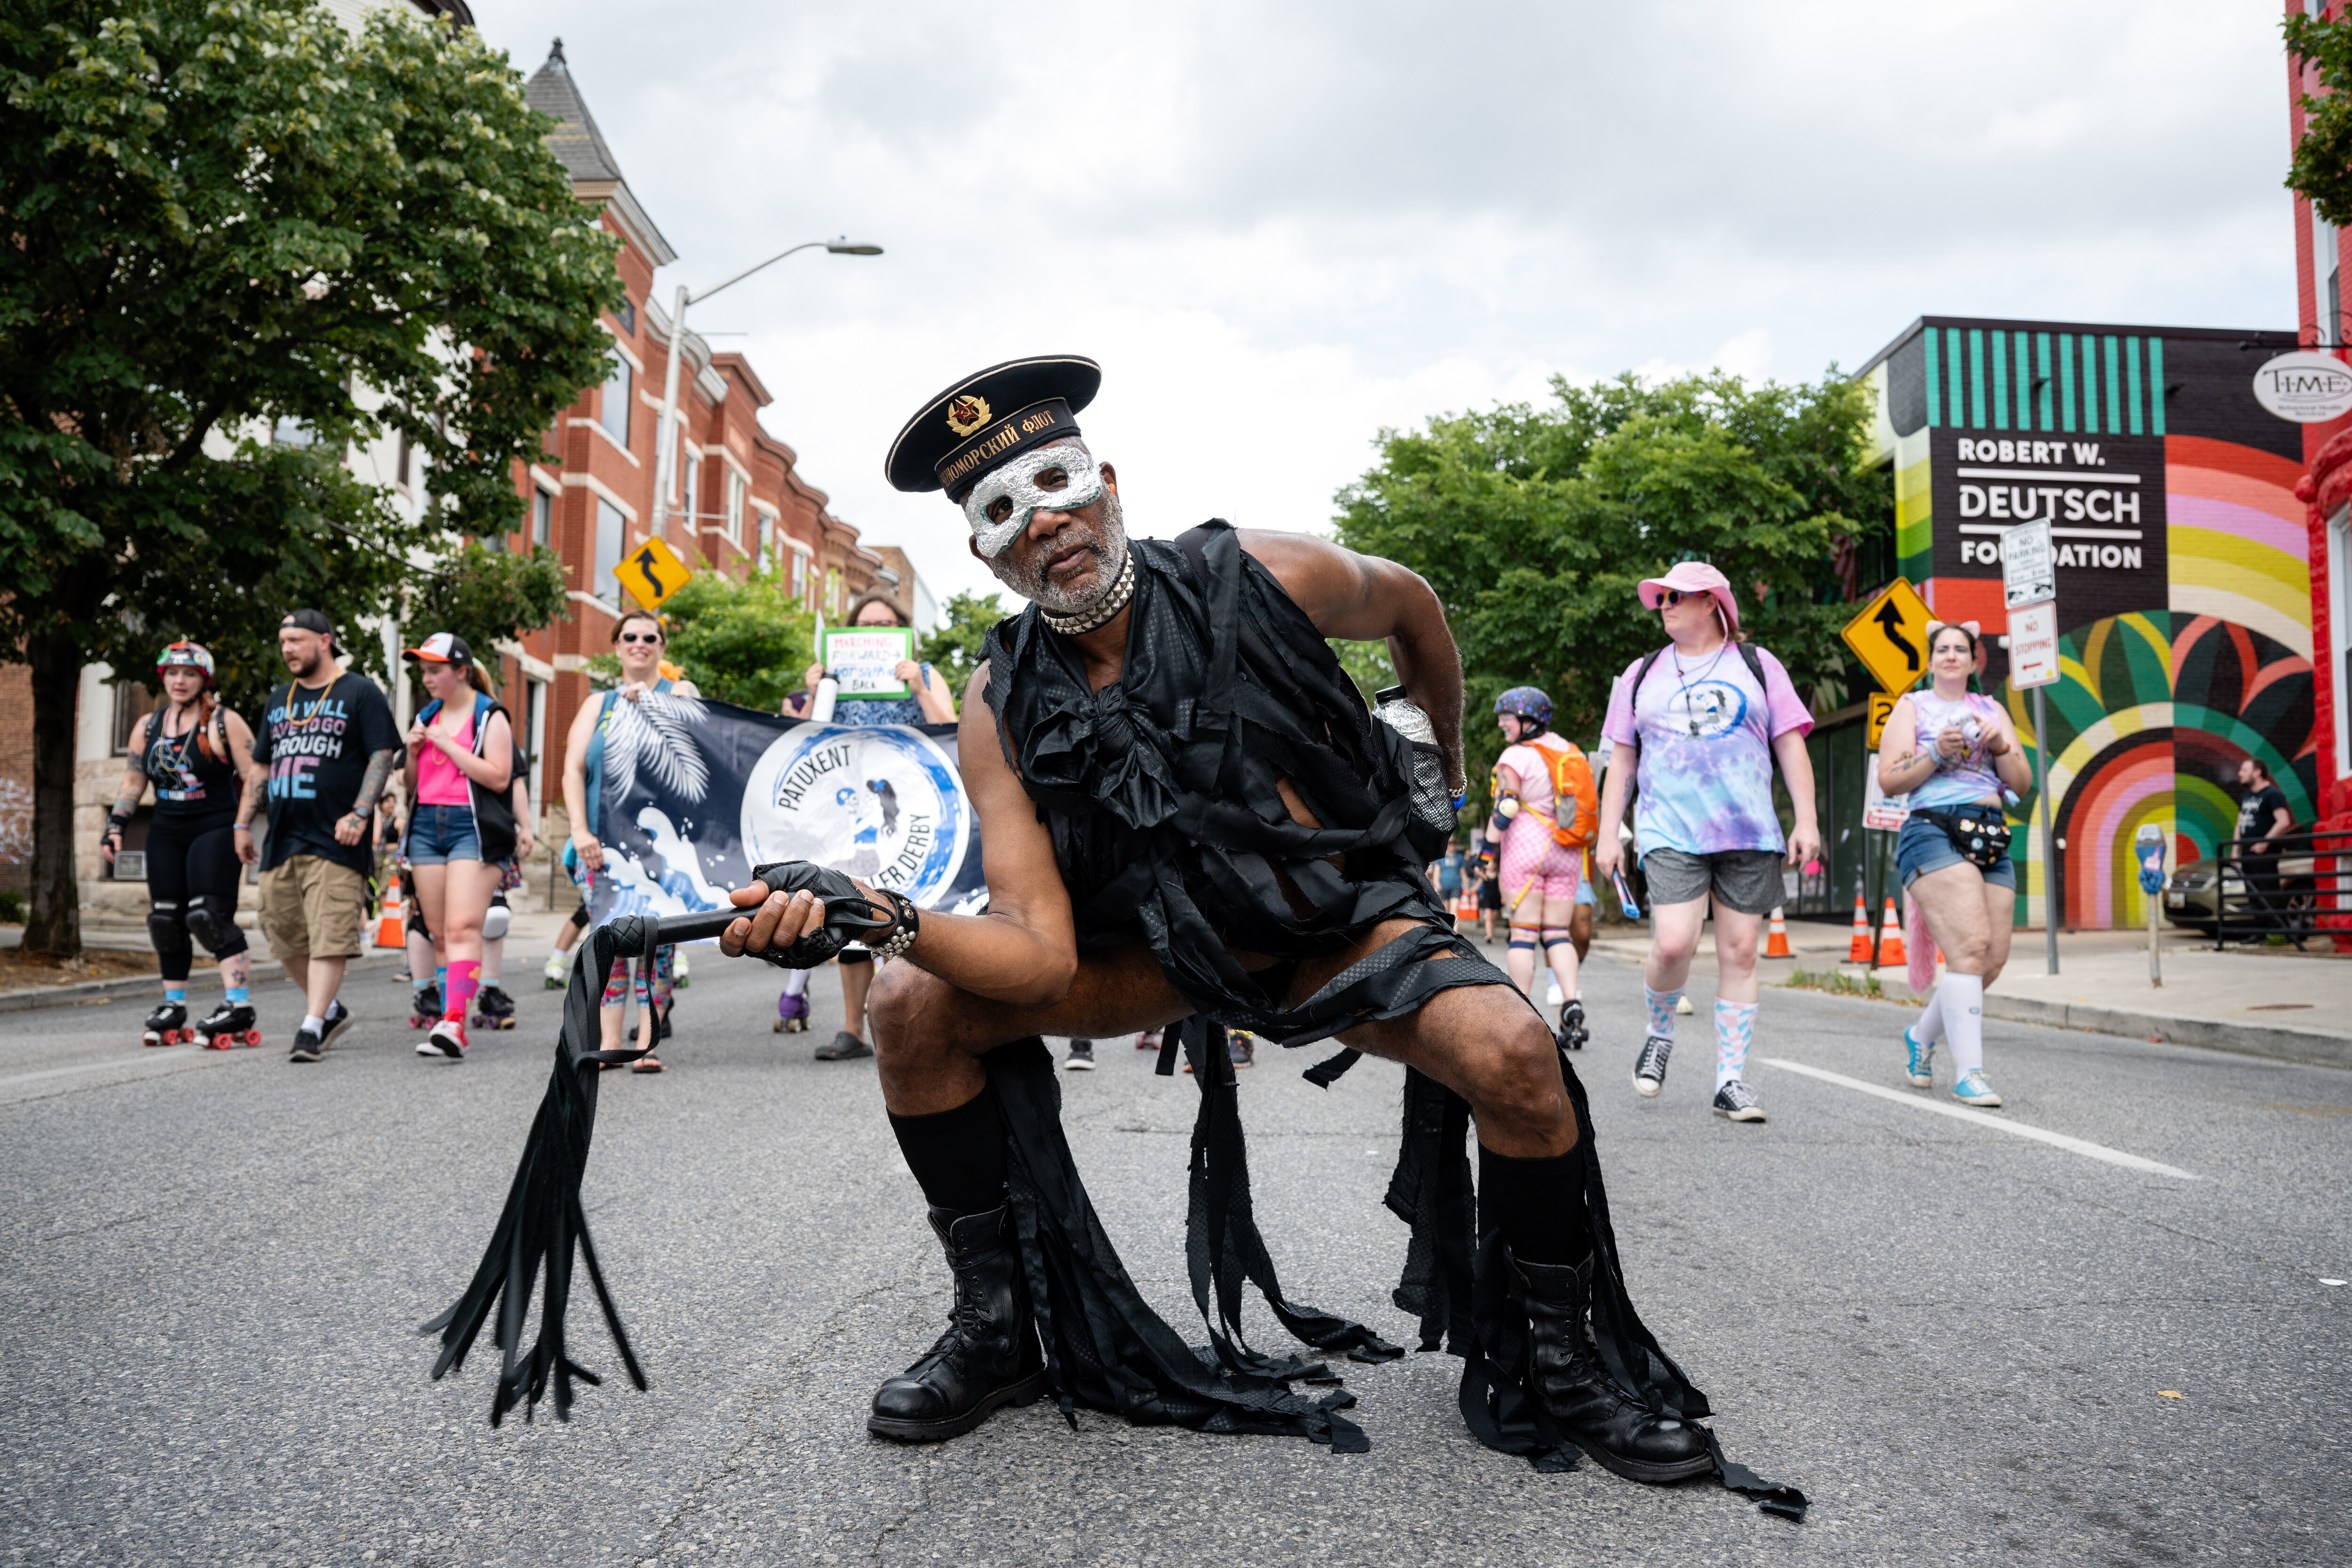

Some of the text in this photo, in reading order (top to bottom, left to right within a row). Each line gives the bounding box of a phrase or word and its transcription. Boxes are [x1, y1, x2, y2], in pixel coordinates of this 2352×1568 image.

[940, 410, 1056, 488] ЧЕРНОМОРСКИЙ ФЛОТ
[1958, 438, 2106, 466] ROBERT W.
[1959, 485, 2141, 524] DEUTSCH
[2019, 535, 2034, 546] NO
[1961, 541, 2142, 569] FOATION
[2009, 542, 2046, 561] PARKING
[2025, 620, 2039, 633] NO
[834, 637, 892, 648] MARCHING
[2015, 637, 2052, 656] STOPPING
[833, 650, 890, 661] FORWARD
[834, 666, 855, 677] NOT
[852, 679, 877, 691] BACK
[267, 699, 349, 723] YOU WILL
[321, 717, 347, 736] GO
[268, 756, 320, 803] ME
[779, 745, 850, 811] PATUXENT
[898, 814, 930, 870] DERBY
